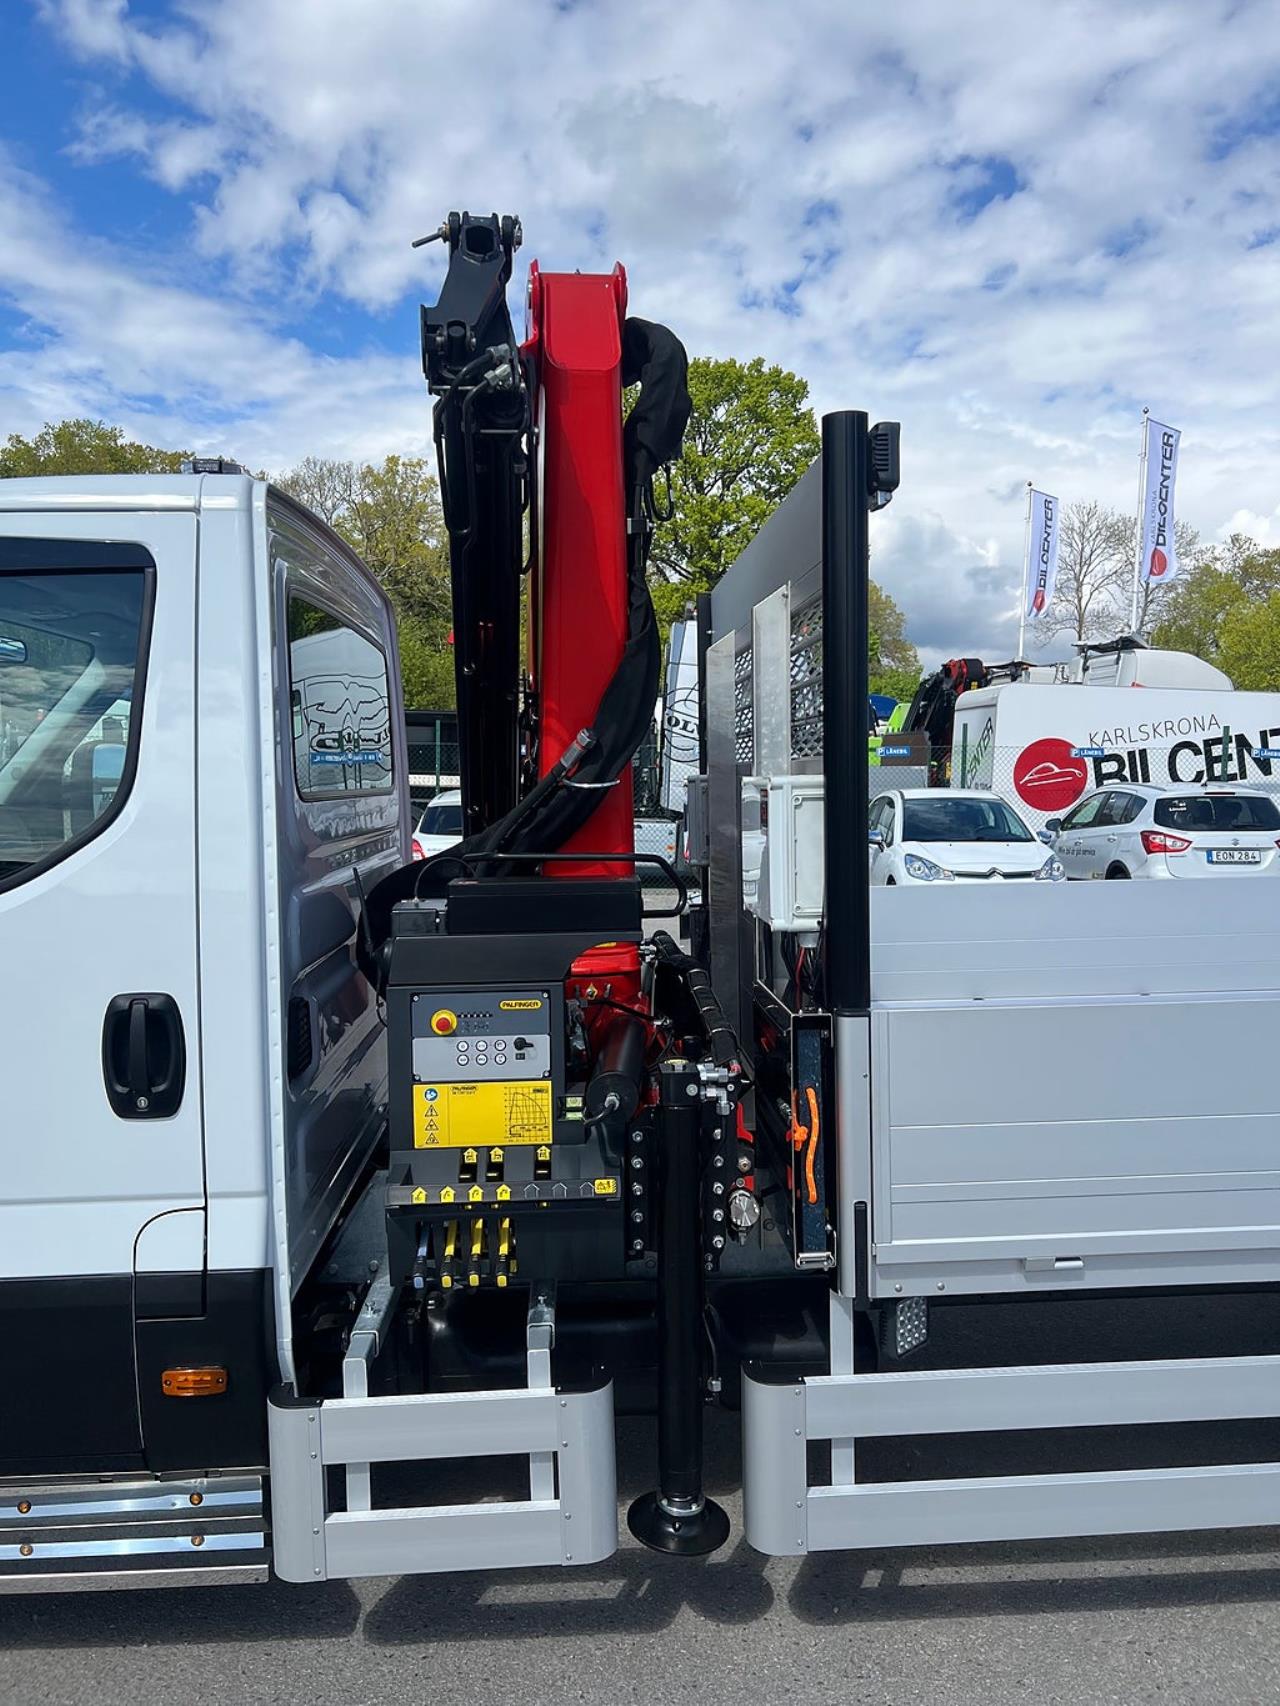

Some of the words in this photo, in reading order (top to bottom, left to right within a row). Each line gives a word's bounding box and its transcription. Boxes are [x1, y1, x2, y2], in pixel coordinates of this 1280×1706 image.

[1089, 714, 1221, 747] KARLSKRONA
[1215, 851, 1235, 861] EON
[1238, 851, 1257, 861] 284
